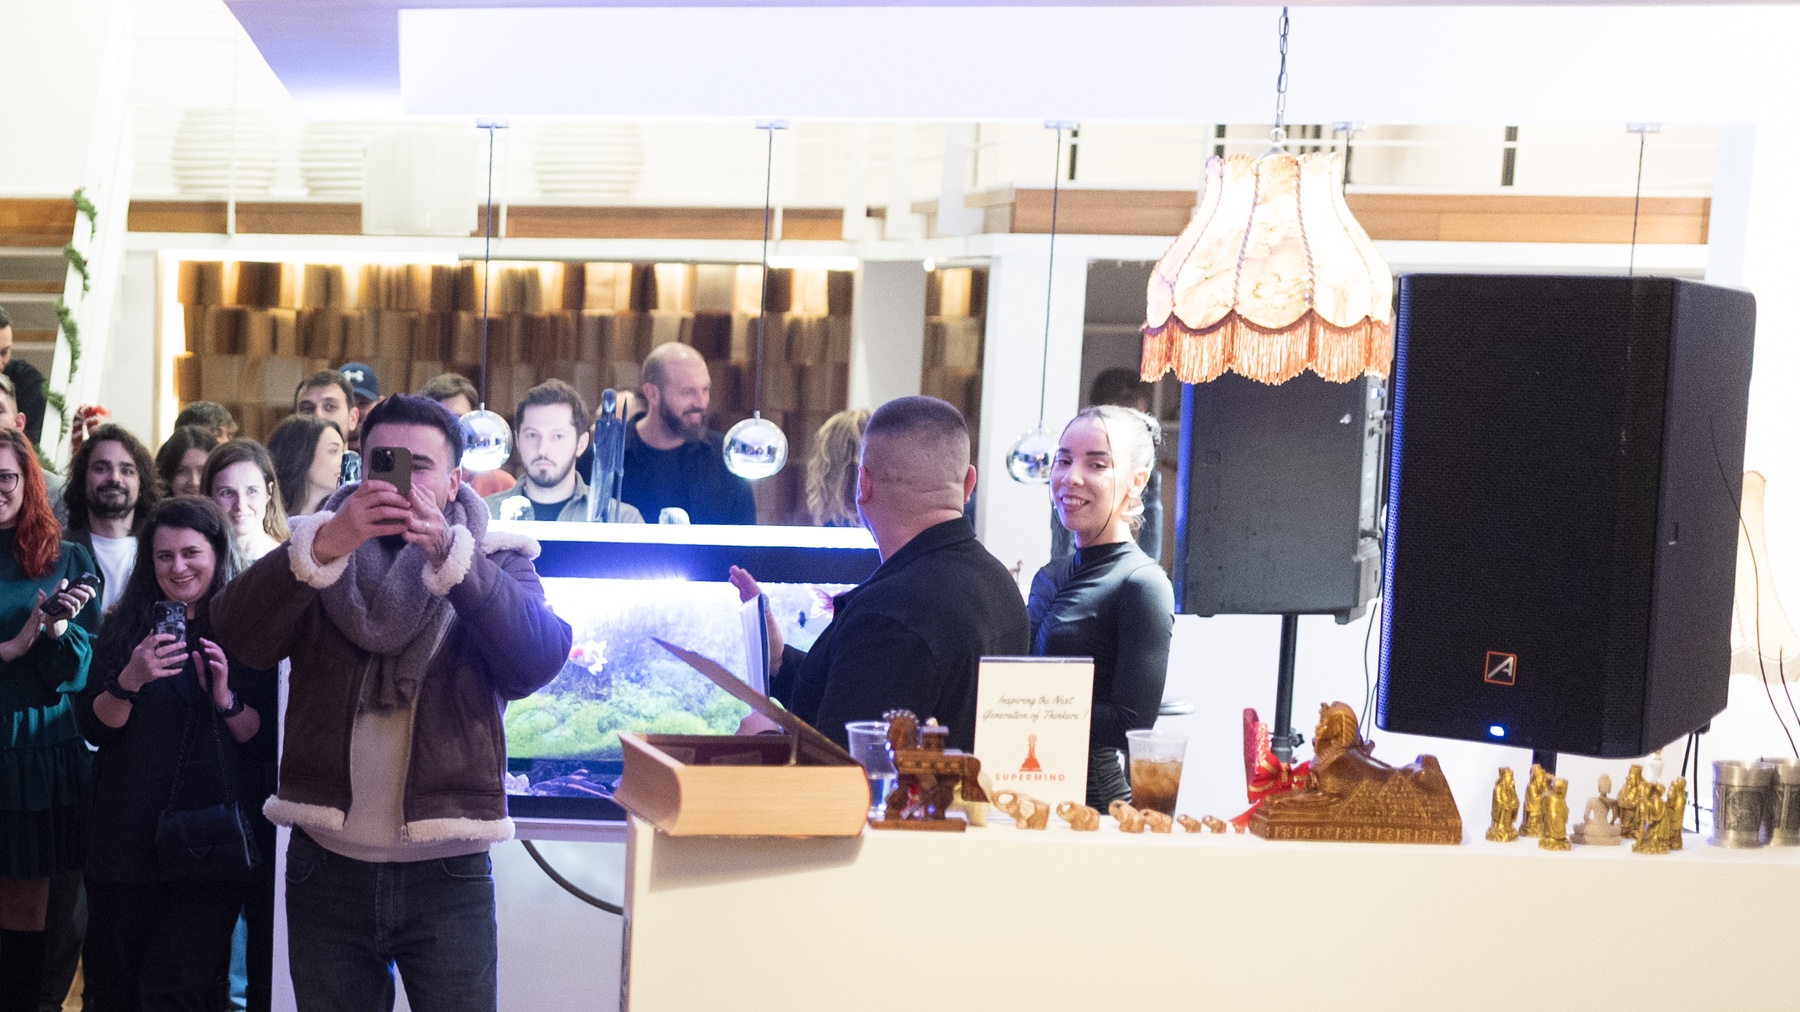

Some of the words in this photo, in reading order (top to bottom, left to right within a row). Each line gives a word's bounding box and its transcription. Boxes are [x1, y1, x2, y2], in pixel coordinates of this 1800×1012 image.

[997, 695, 1036, 707] Inspiring
[1038, 696, 1050, 705] the
[1053, 695, 1075, 705] Next
[982, 709, 1028, 721] Generation
[1030, 710, 1040, 723] of
[1043, 710, 1079, 720] Thinkers
[995, 773, 1066, 781] SUPERMIND
